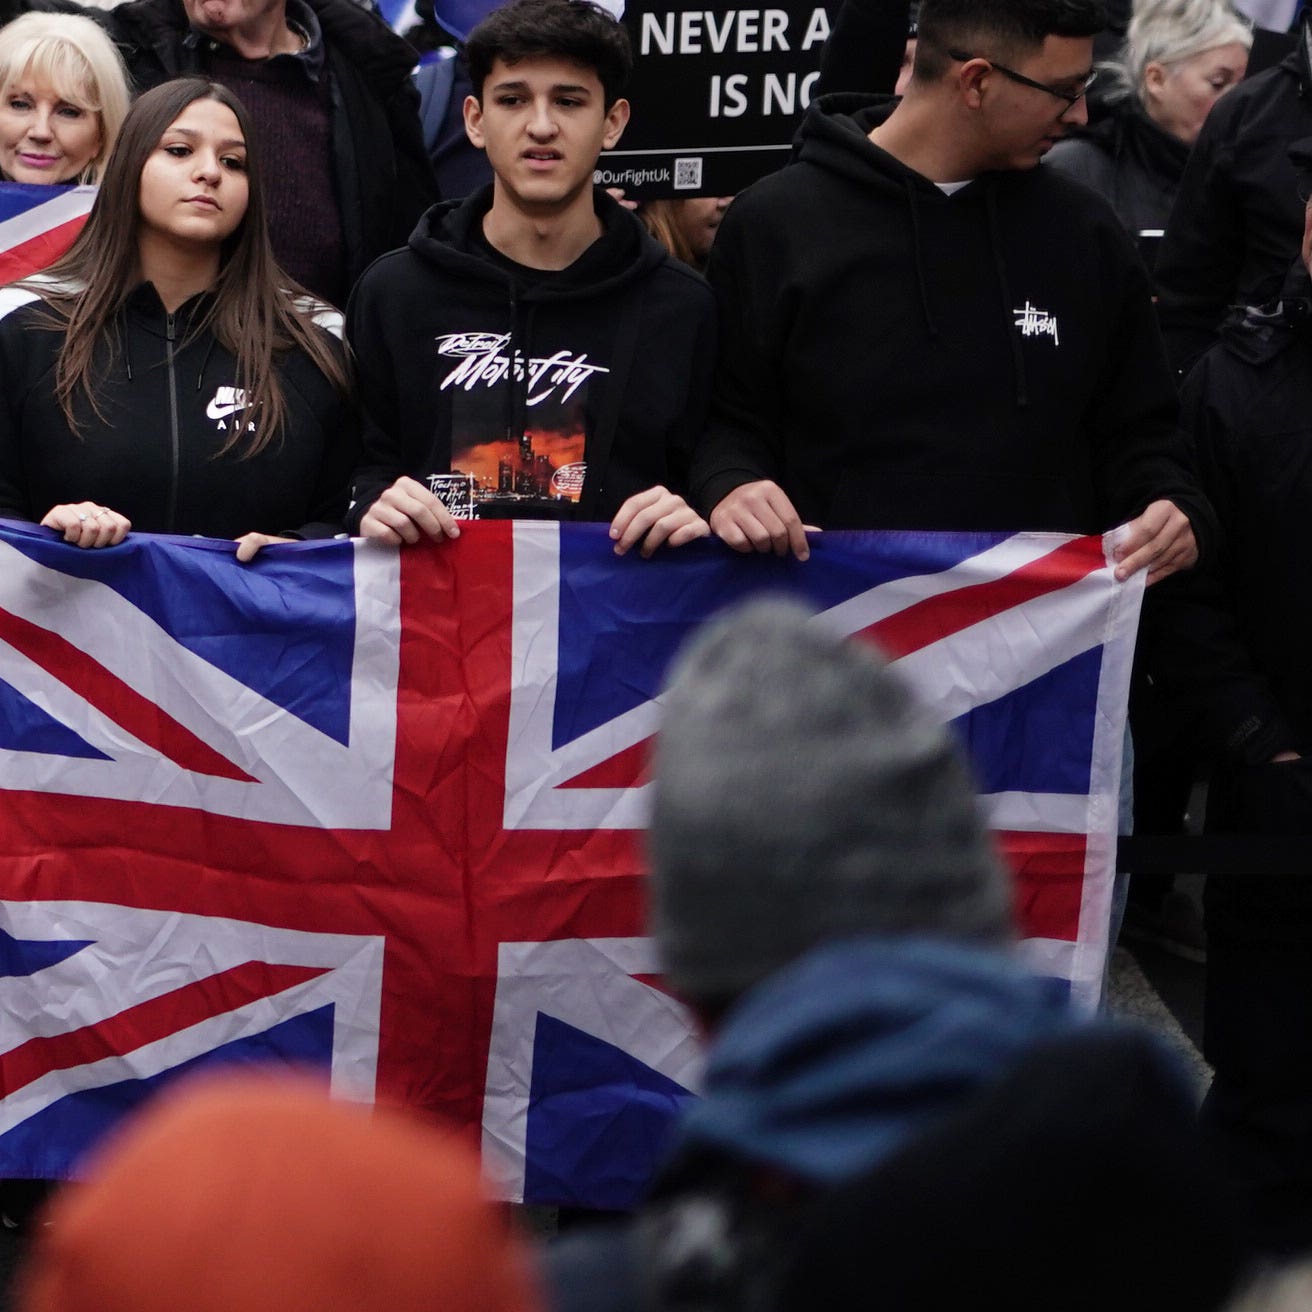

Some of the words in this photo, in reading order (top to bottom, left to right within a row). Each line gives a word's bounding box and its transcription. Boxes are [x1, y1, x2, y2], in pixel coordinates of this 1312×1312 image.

[641, 9, 791, 55] NEVER
[710, 74, 748, 118] IS
[593, 168, 670, 185] @OurFightUk
[217, 419, 256, 432] AIR
